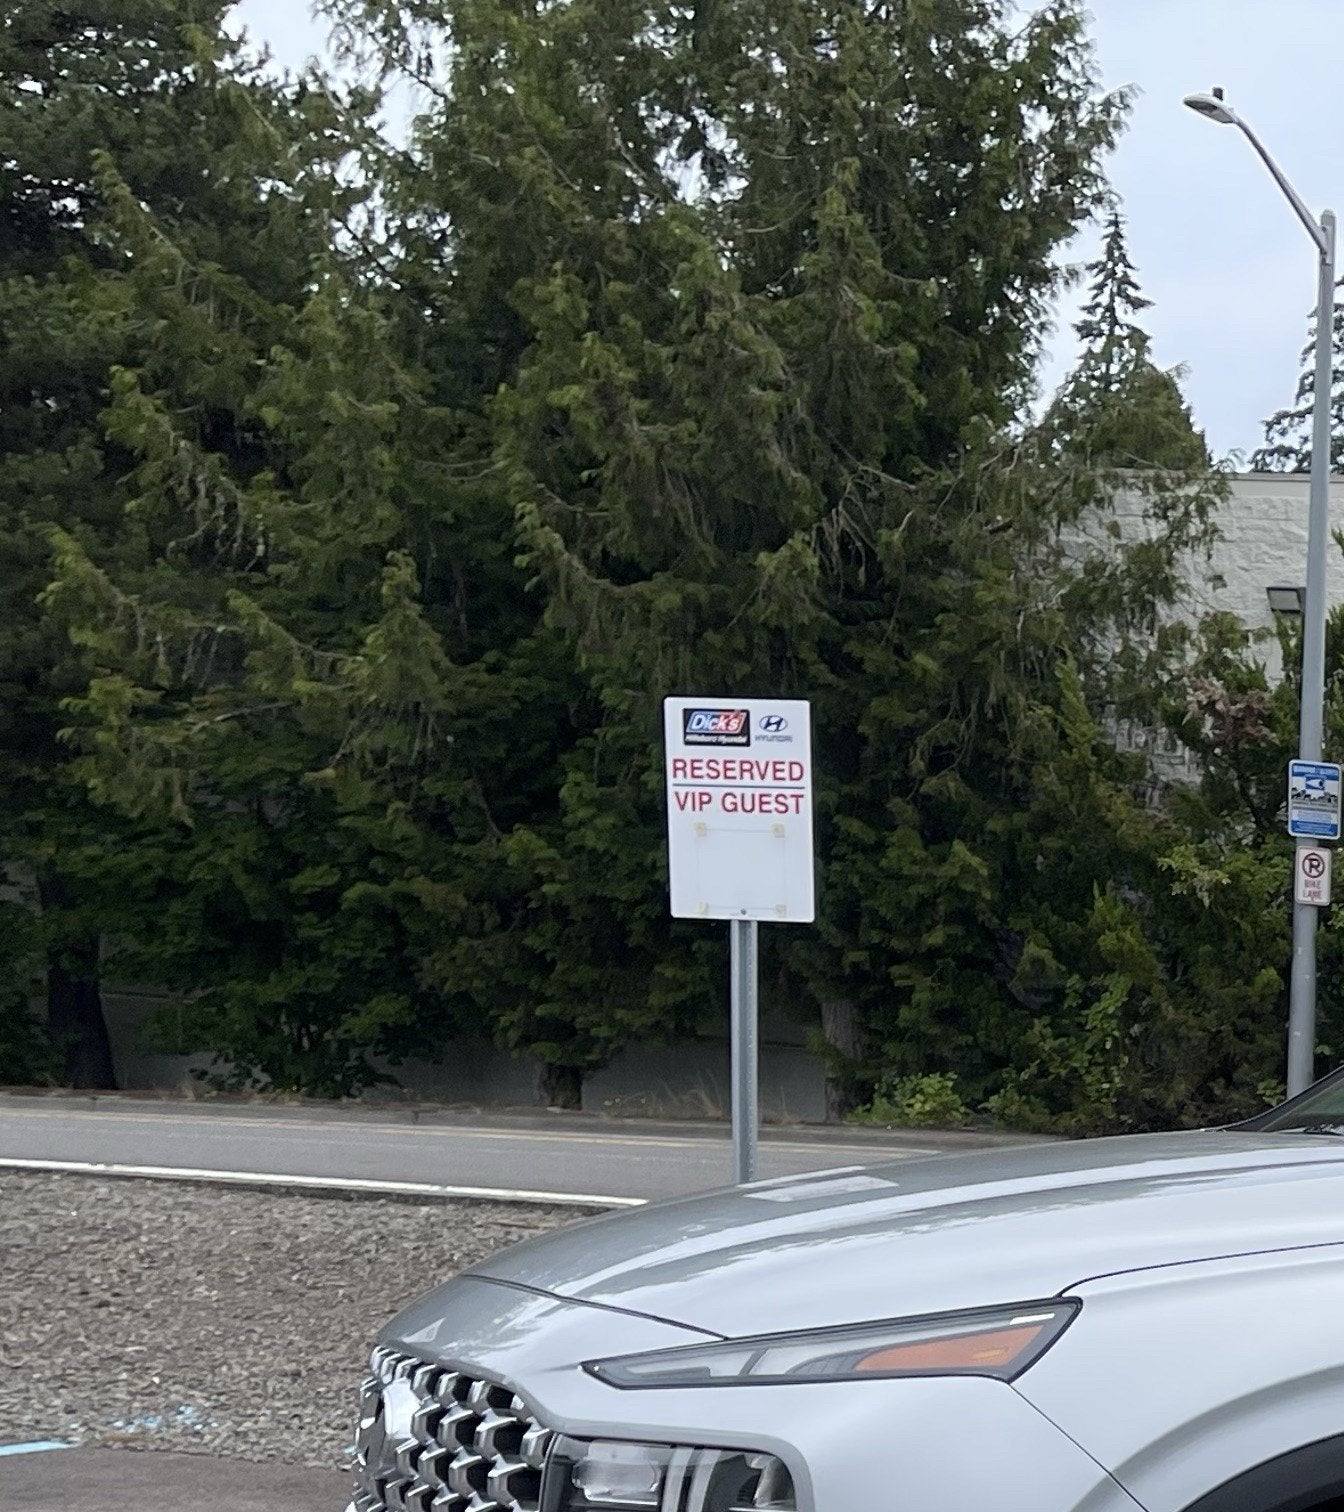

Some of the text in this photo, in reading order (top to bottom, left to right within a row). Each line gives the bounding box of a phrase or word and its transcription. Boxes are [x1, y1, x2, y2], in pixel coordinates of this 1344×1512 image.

[691, 714, 740, 731] Dick's
[672, 758, 805, 782] RESERVED
[674, 791, 805, 815] VIP GUEST
